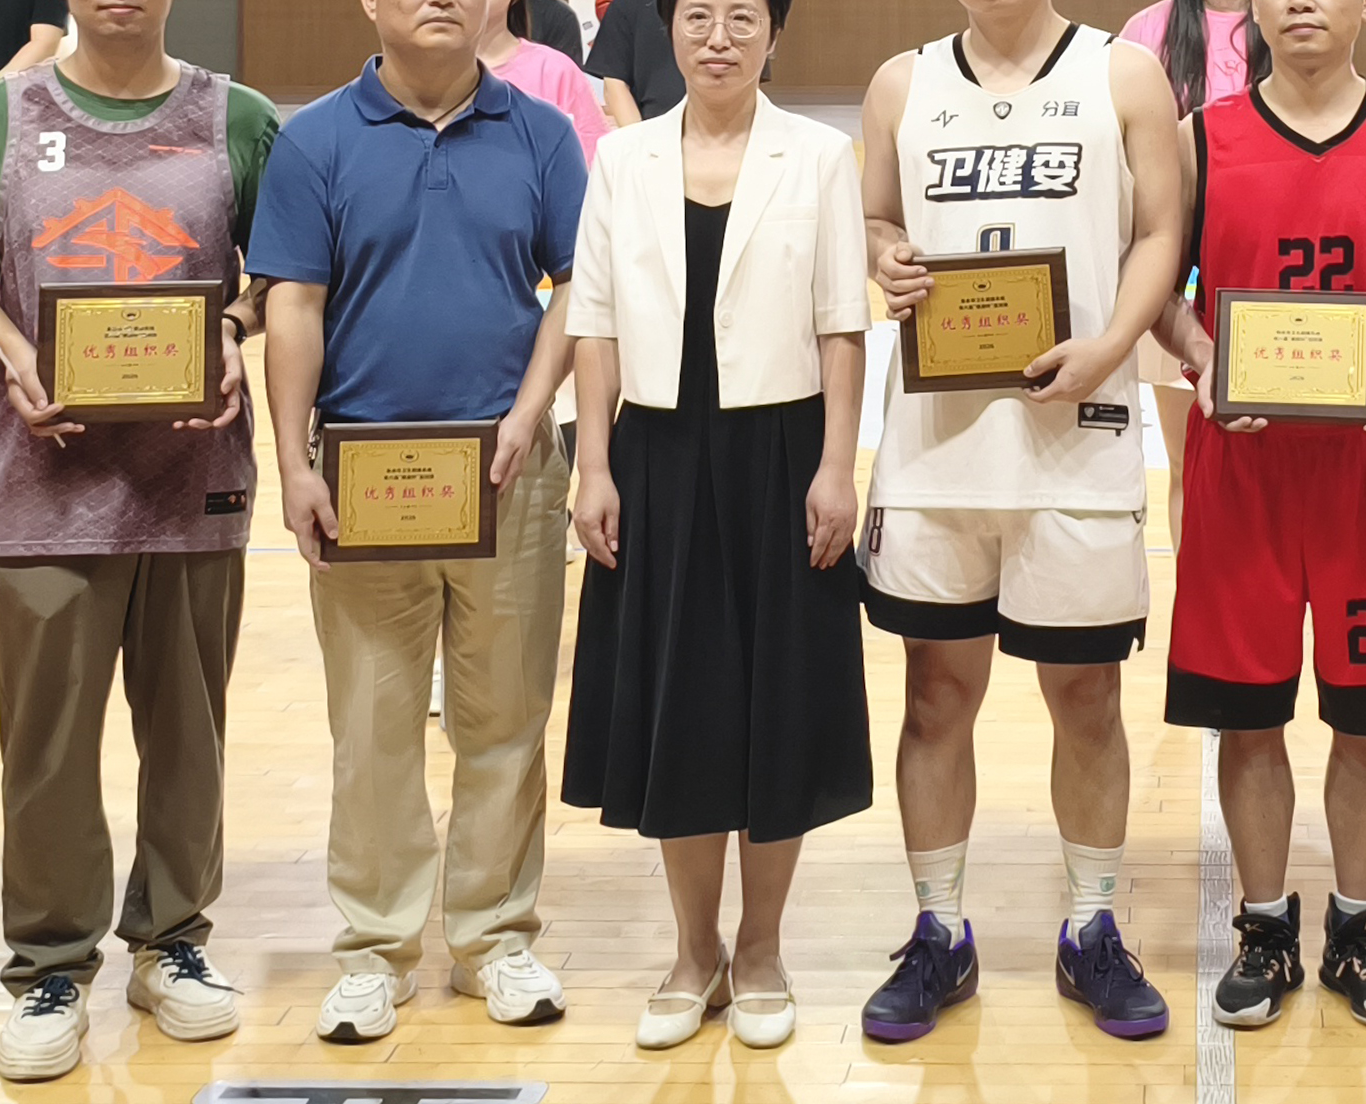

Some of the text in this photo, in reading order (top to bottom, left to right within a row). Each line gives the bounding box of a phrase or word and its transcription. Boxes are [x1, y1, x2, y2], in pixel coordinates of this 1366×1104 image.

[37, 131, 66, 172] 3
[926, 144, 1081, 199] 卫健委
[1278, 235, 1354, 291] 22
